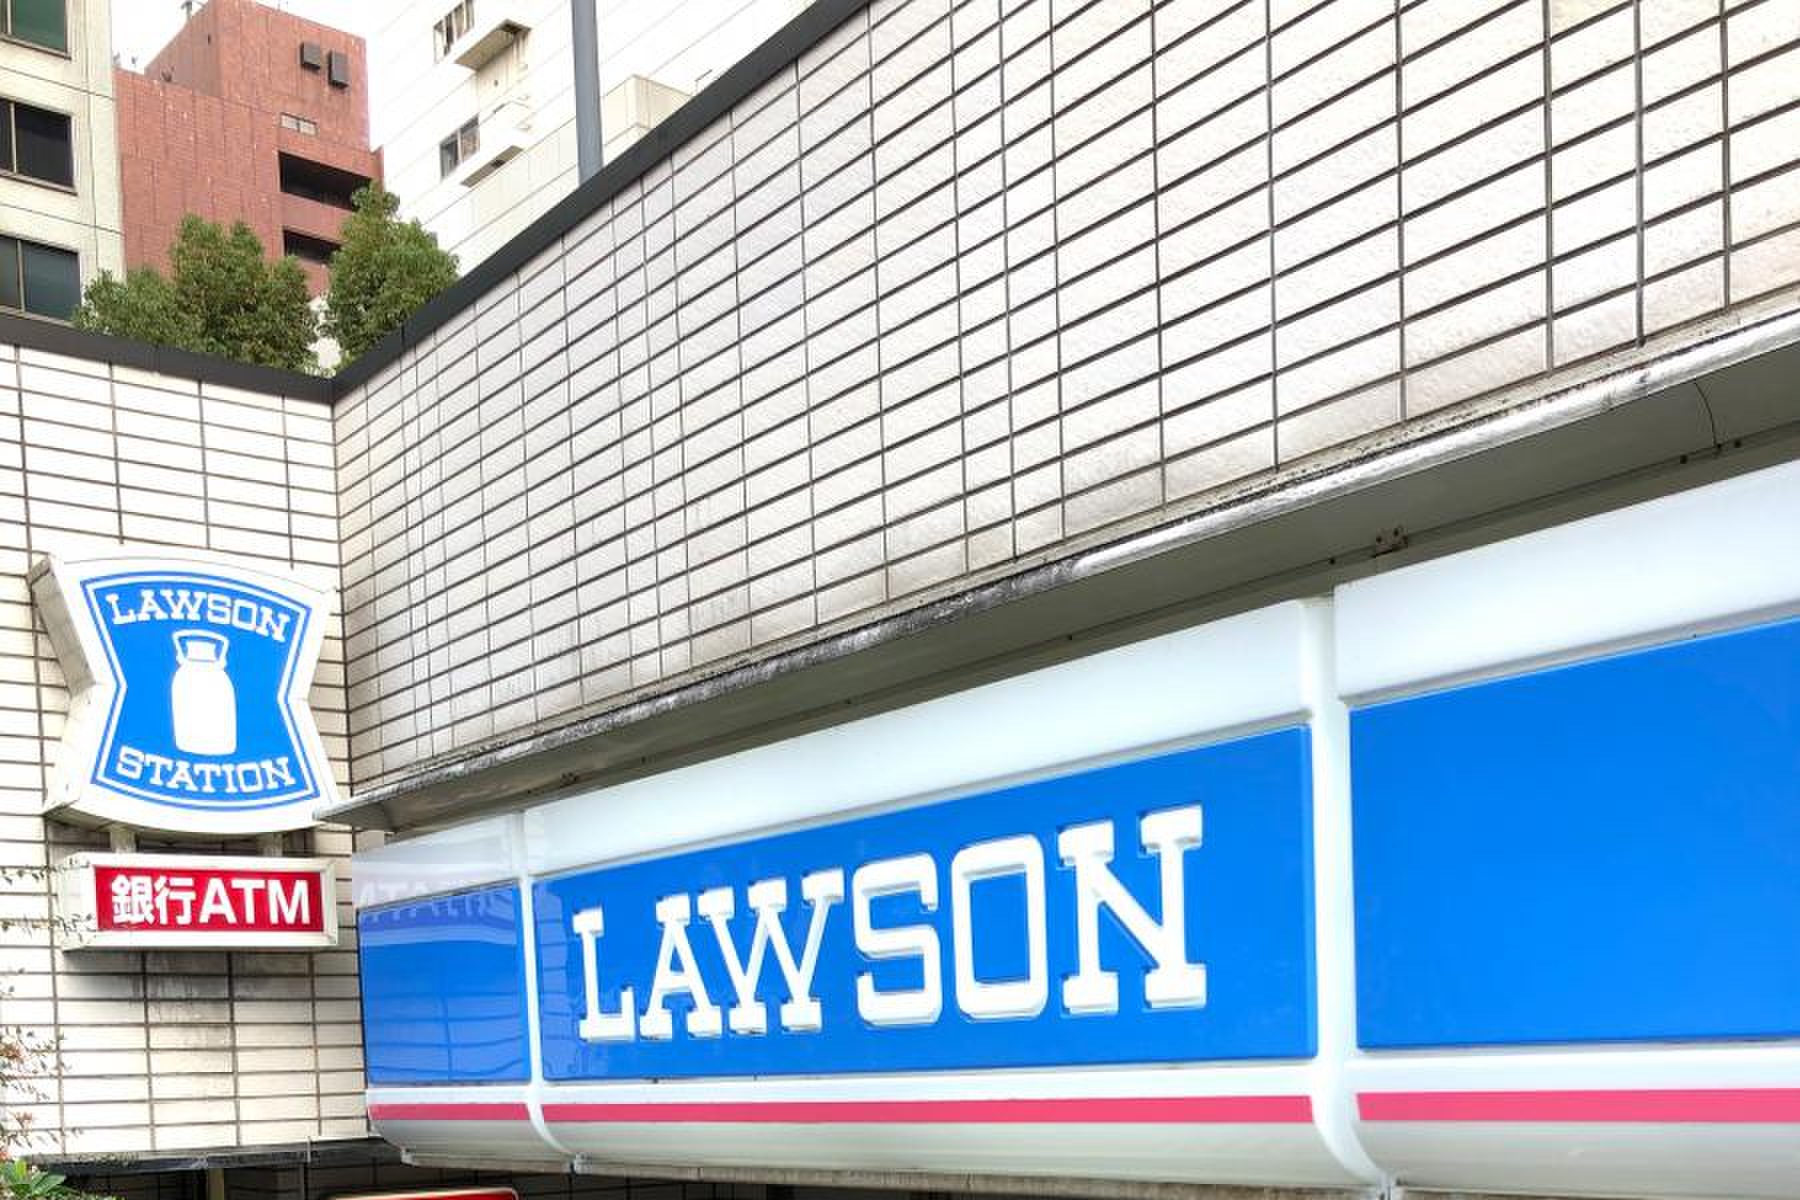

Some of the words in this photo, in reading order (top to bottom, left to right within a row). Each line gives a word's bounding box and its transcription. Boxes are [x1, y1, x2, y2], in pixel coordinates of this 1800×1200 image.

[105, 589, 290, 643] LAWSON
[116, 746, 295, 794] STATION
[111, 875, 311, 926] 銀行ATM
[573, 805, 1207, 1041] LAWSON
